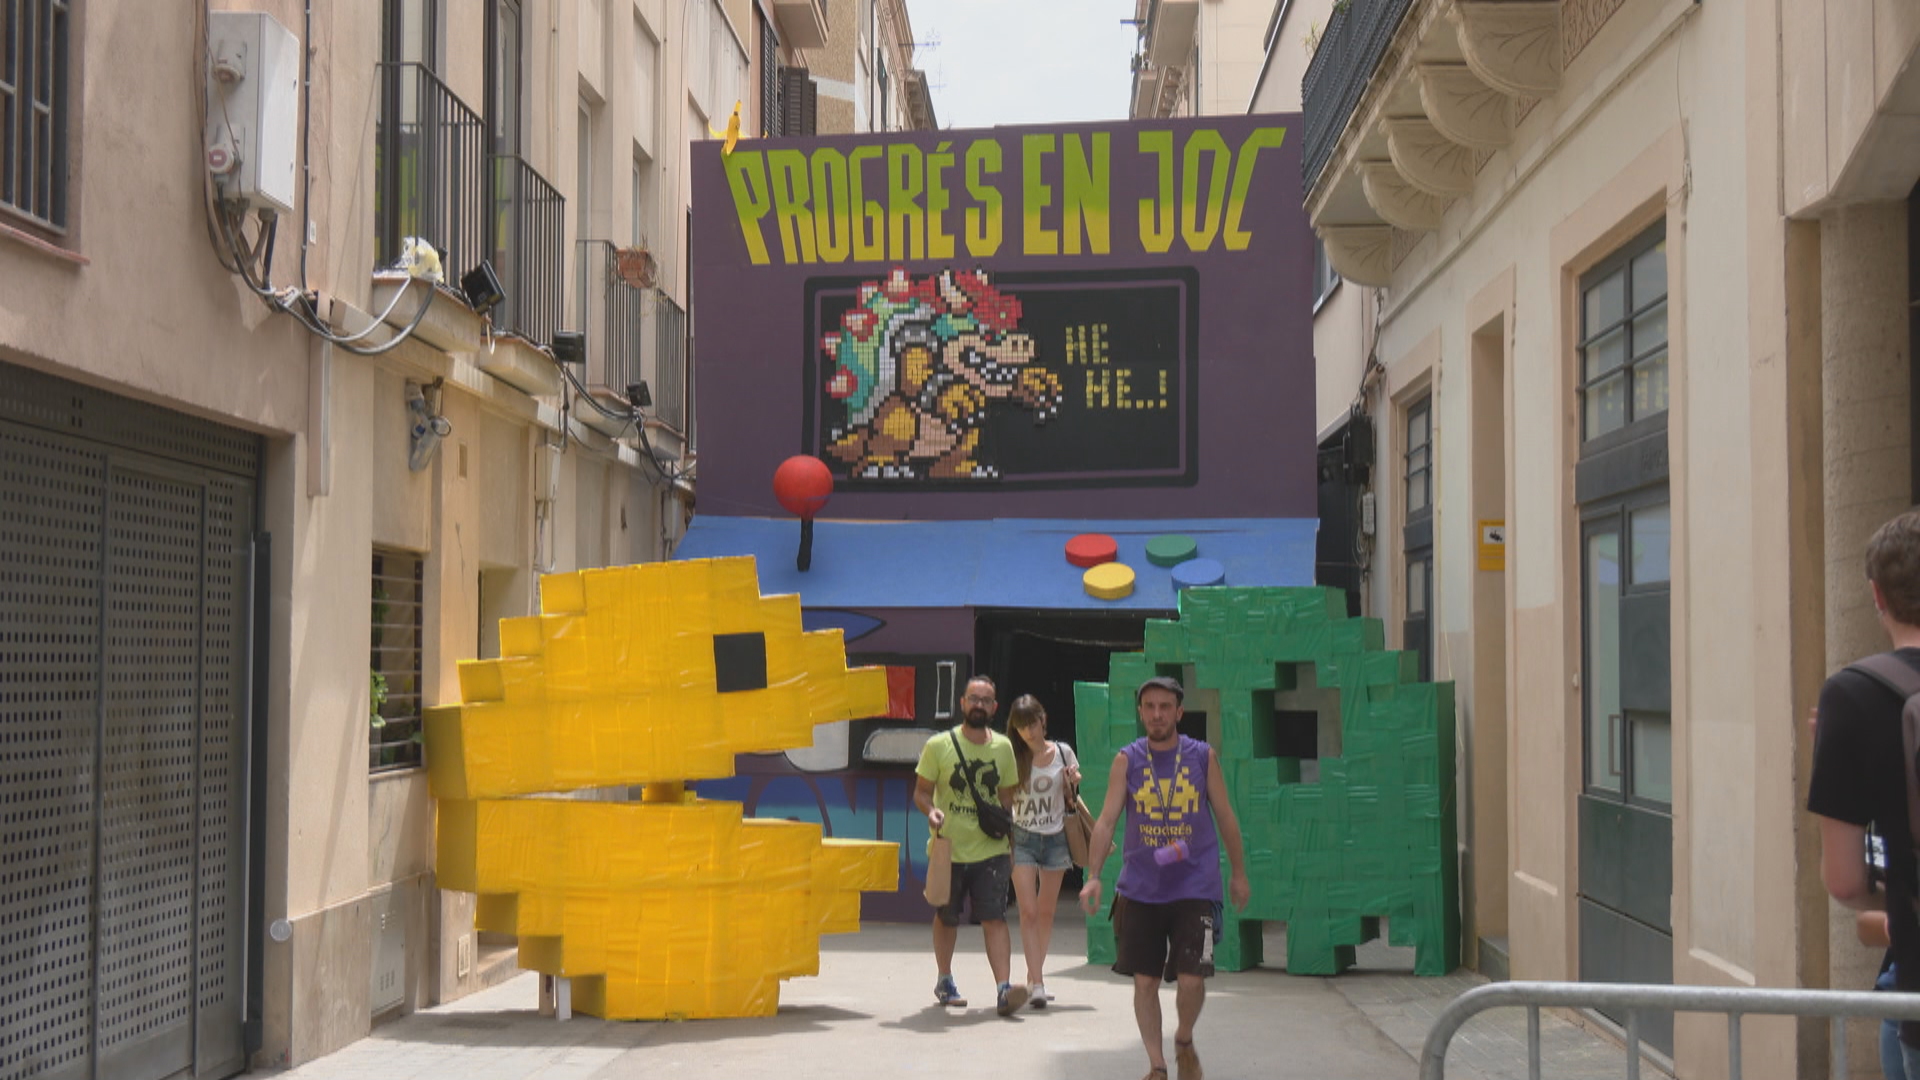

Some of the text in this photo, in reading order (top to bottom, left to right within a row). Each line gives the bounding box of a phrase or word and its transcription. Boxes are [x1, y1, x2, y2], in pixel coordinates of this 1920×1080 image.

[721, 127, 1287, 264] PROGRÉS EN JOC
[1065, 323, 1109, 365] HE
[1016, 797, 1052, 815] TAN
